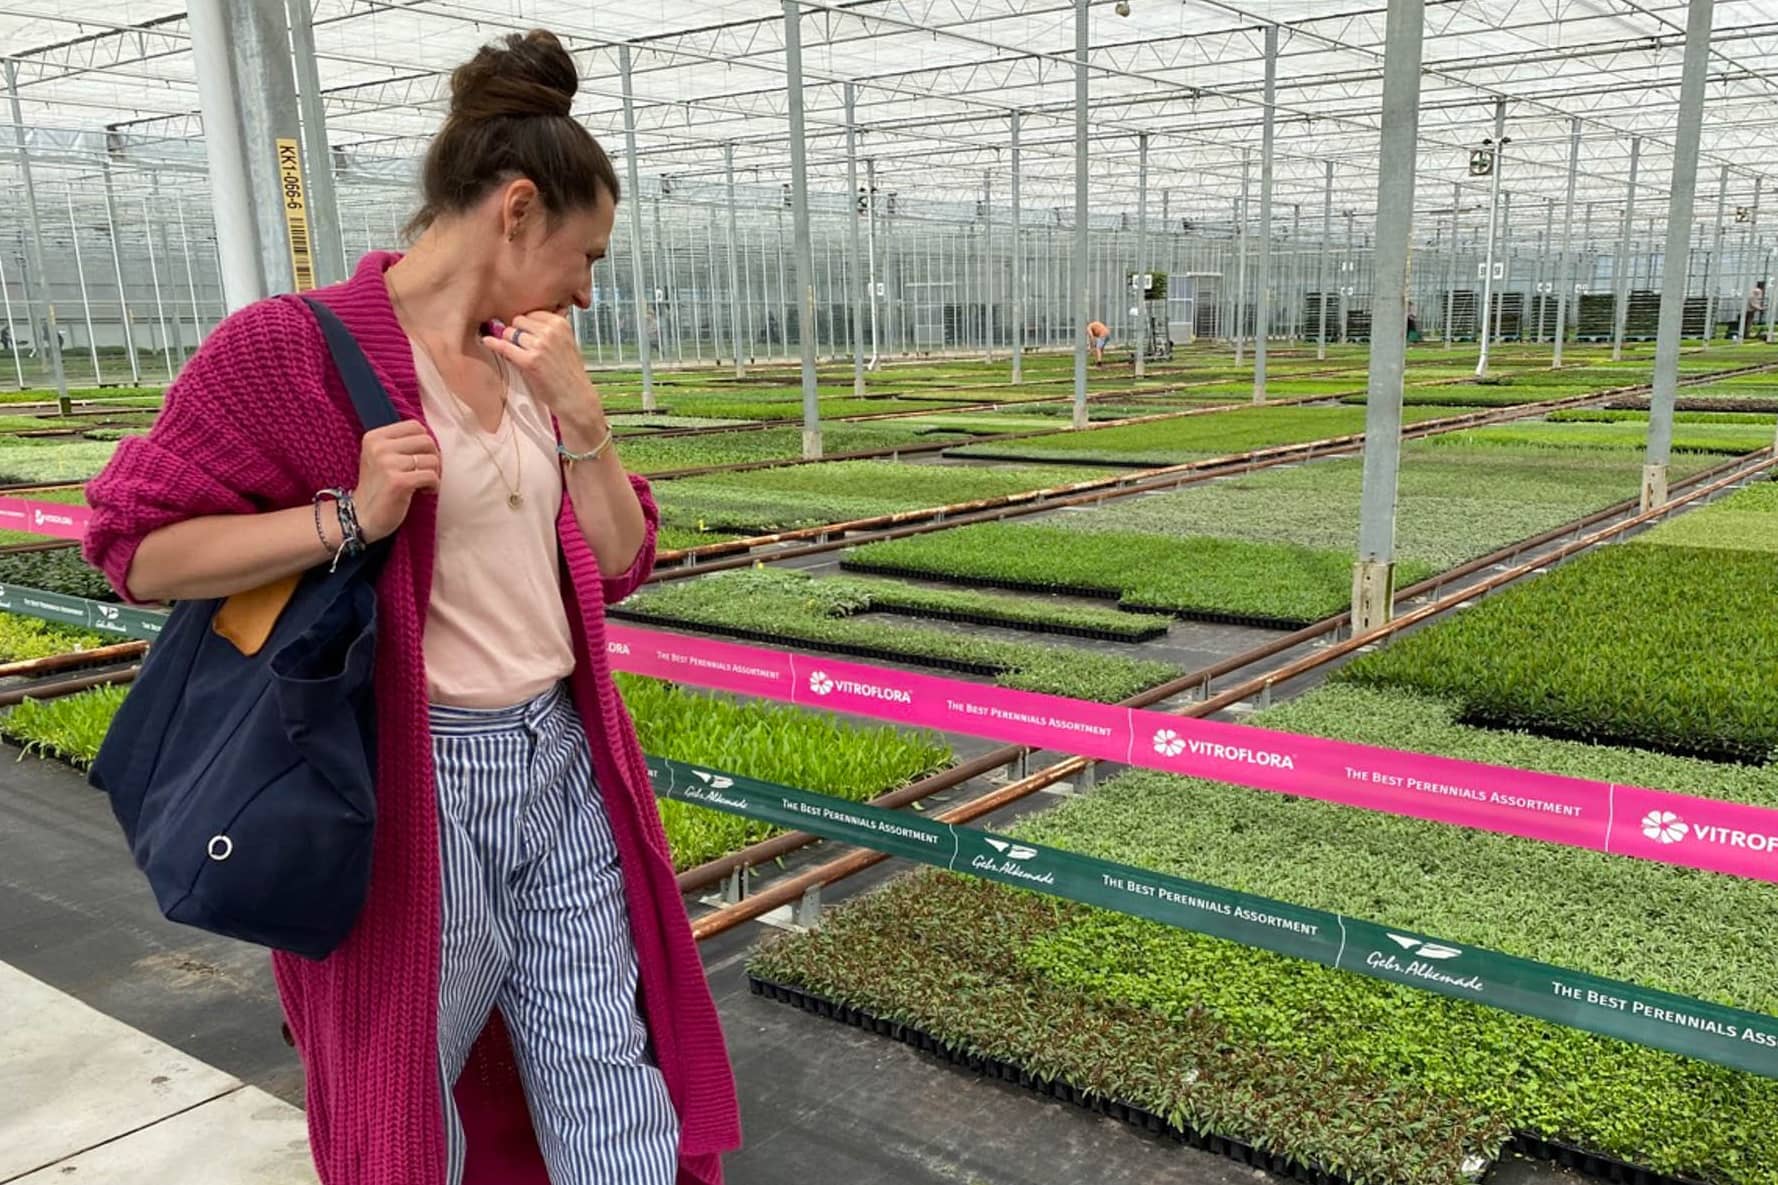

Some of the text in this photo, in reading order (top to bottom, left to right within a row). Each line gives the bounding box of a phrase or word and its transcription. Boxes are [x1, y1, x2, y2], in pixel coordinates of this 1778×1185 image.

[279, 145, 303, 210] KK1-066-6
[835, 680, 911, 703] VITROFLORA
[947, 700, 1111, 736] THE BEST PERENNIALS ASSORTMENT
[1188, 740, 1293, 769] VITROFLORA
[1346, 768, 1581, 816] THE BEST PERENNIALS ASSORTMENT
[783, 799, 939, 843] THE BEST PERENNIALS ASSORTMENT
[1103, 875, 1319, 935] THE BEST PERENNIALS ASSORTMENT
[1403, 960, 1482, 992] Alkemade
[1552, 982, 1582, 999] THE
[1588, 990, 1626, 1010] BEST
[1633, 1001, 1737, 1037] PERENNIALS
